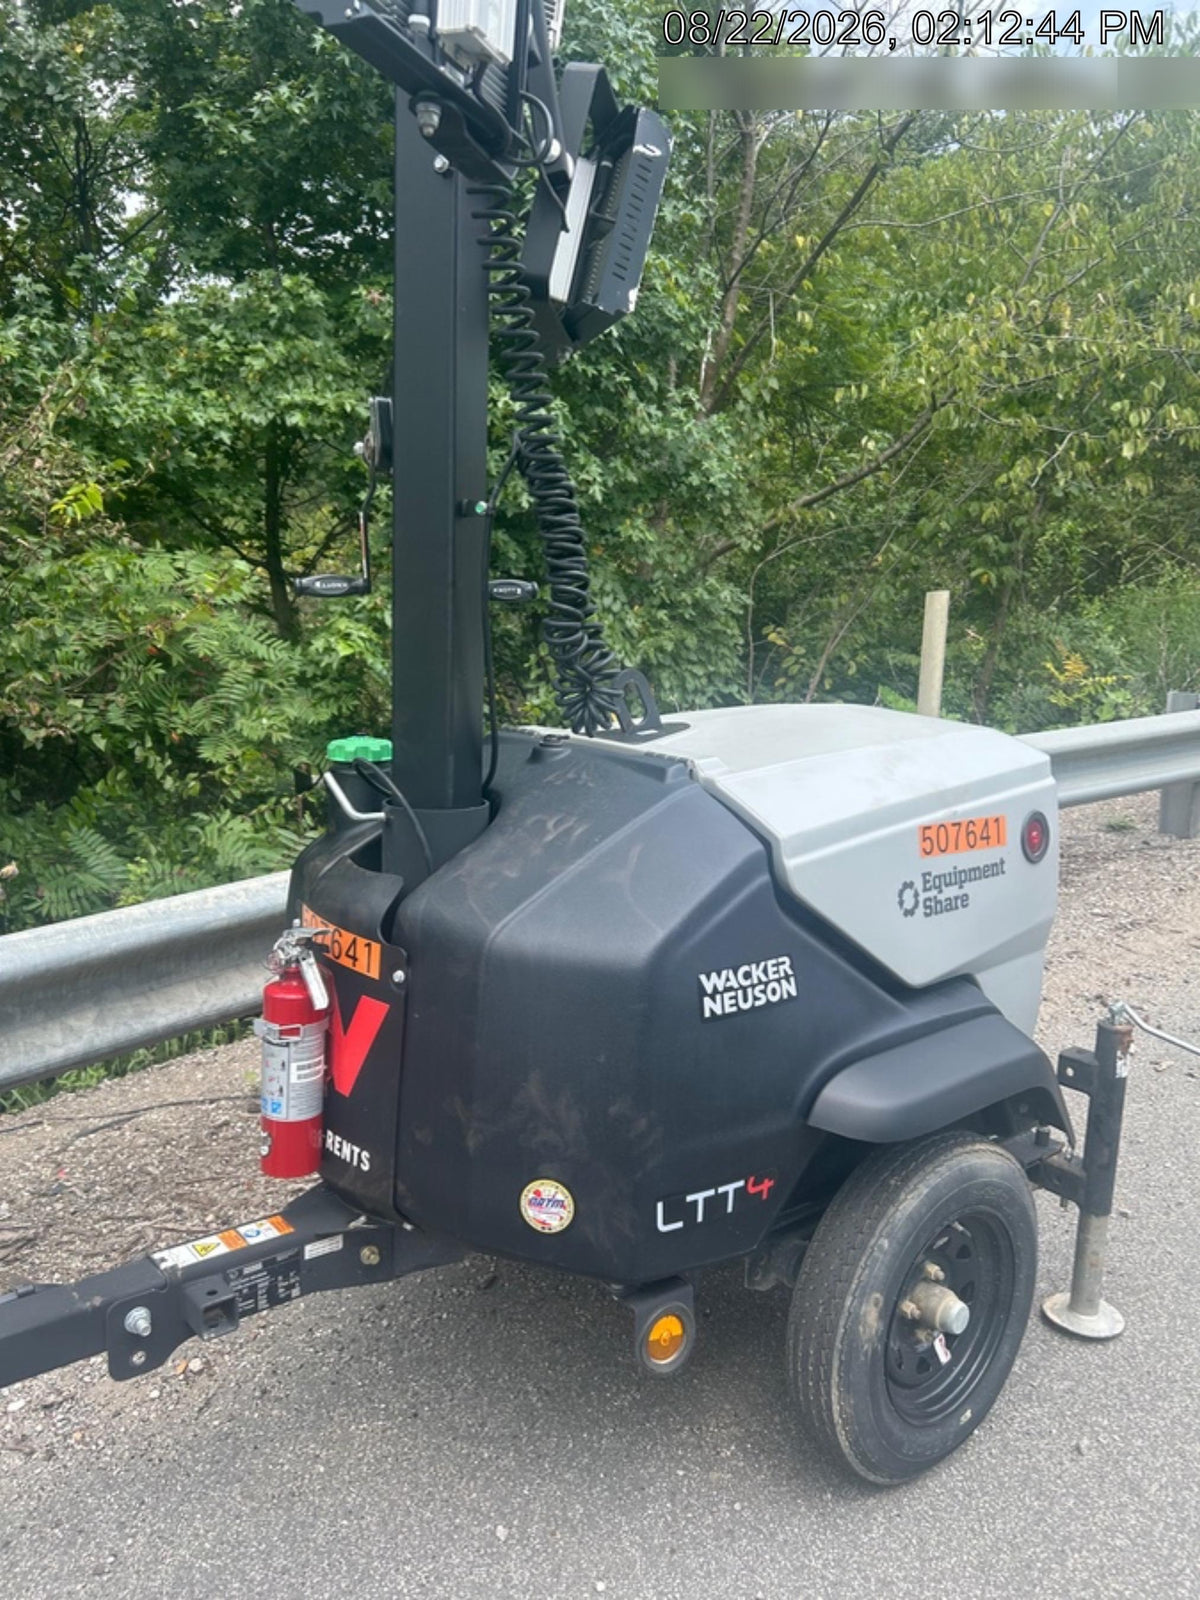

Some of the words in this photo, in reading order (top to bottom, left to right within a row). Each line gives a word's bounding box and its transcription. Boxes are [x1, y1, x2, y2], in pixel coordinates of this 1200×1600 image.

[921, 816, 1002, 856] 507641
[921, 857, 1006, 894] Equipment
[923, 893, 970, 918] Share
[698, 955, 794, 994] WACKER
[703, 976, 797, 1018] NEUSON
[326, 1129, 371, 1172] RENTS
